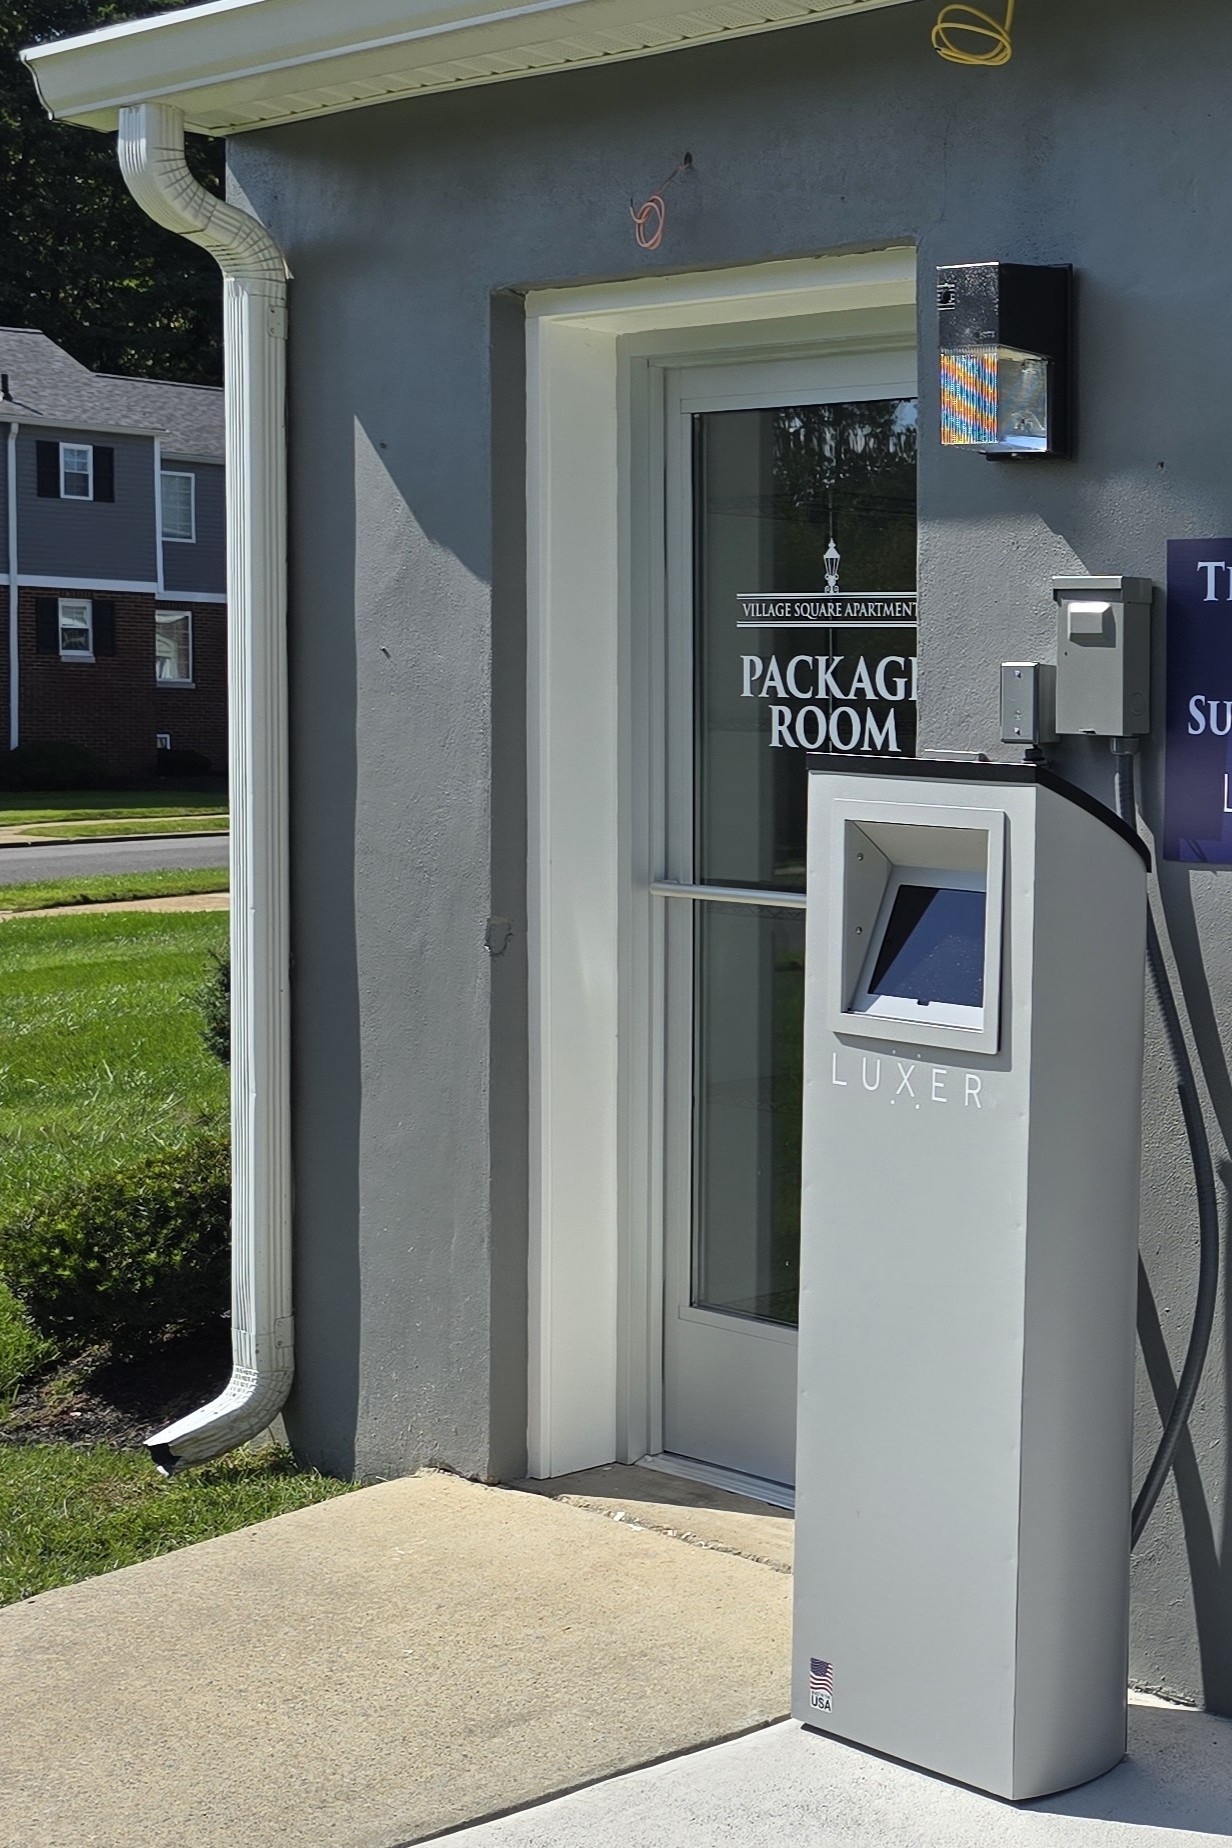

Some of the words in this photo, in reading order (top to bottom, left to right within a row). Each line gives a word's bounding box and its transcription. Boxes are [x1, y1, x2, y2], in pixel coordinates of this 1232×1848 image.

[743, 602, 791, 617] VILLAGE
[794, 602, 842, 620] SQUARE
[768, 705, 902, 752] ROOM
[831, 1053, 983, 1108] LUXER
[811, 1694, 831, 1711] USA
